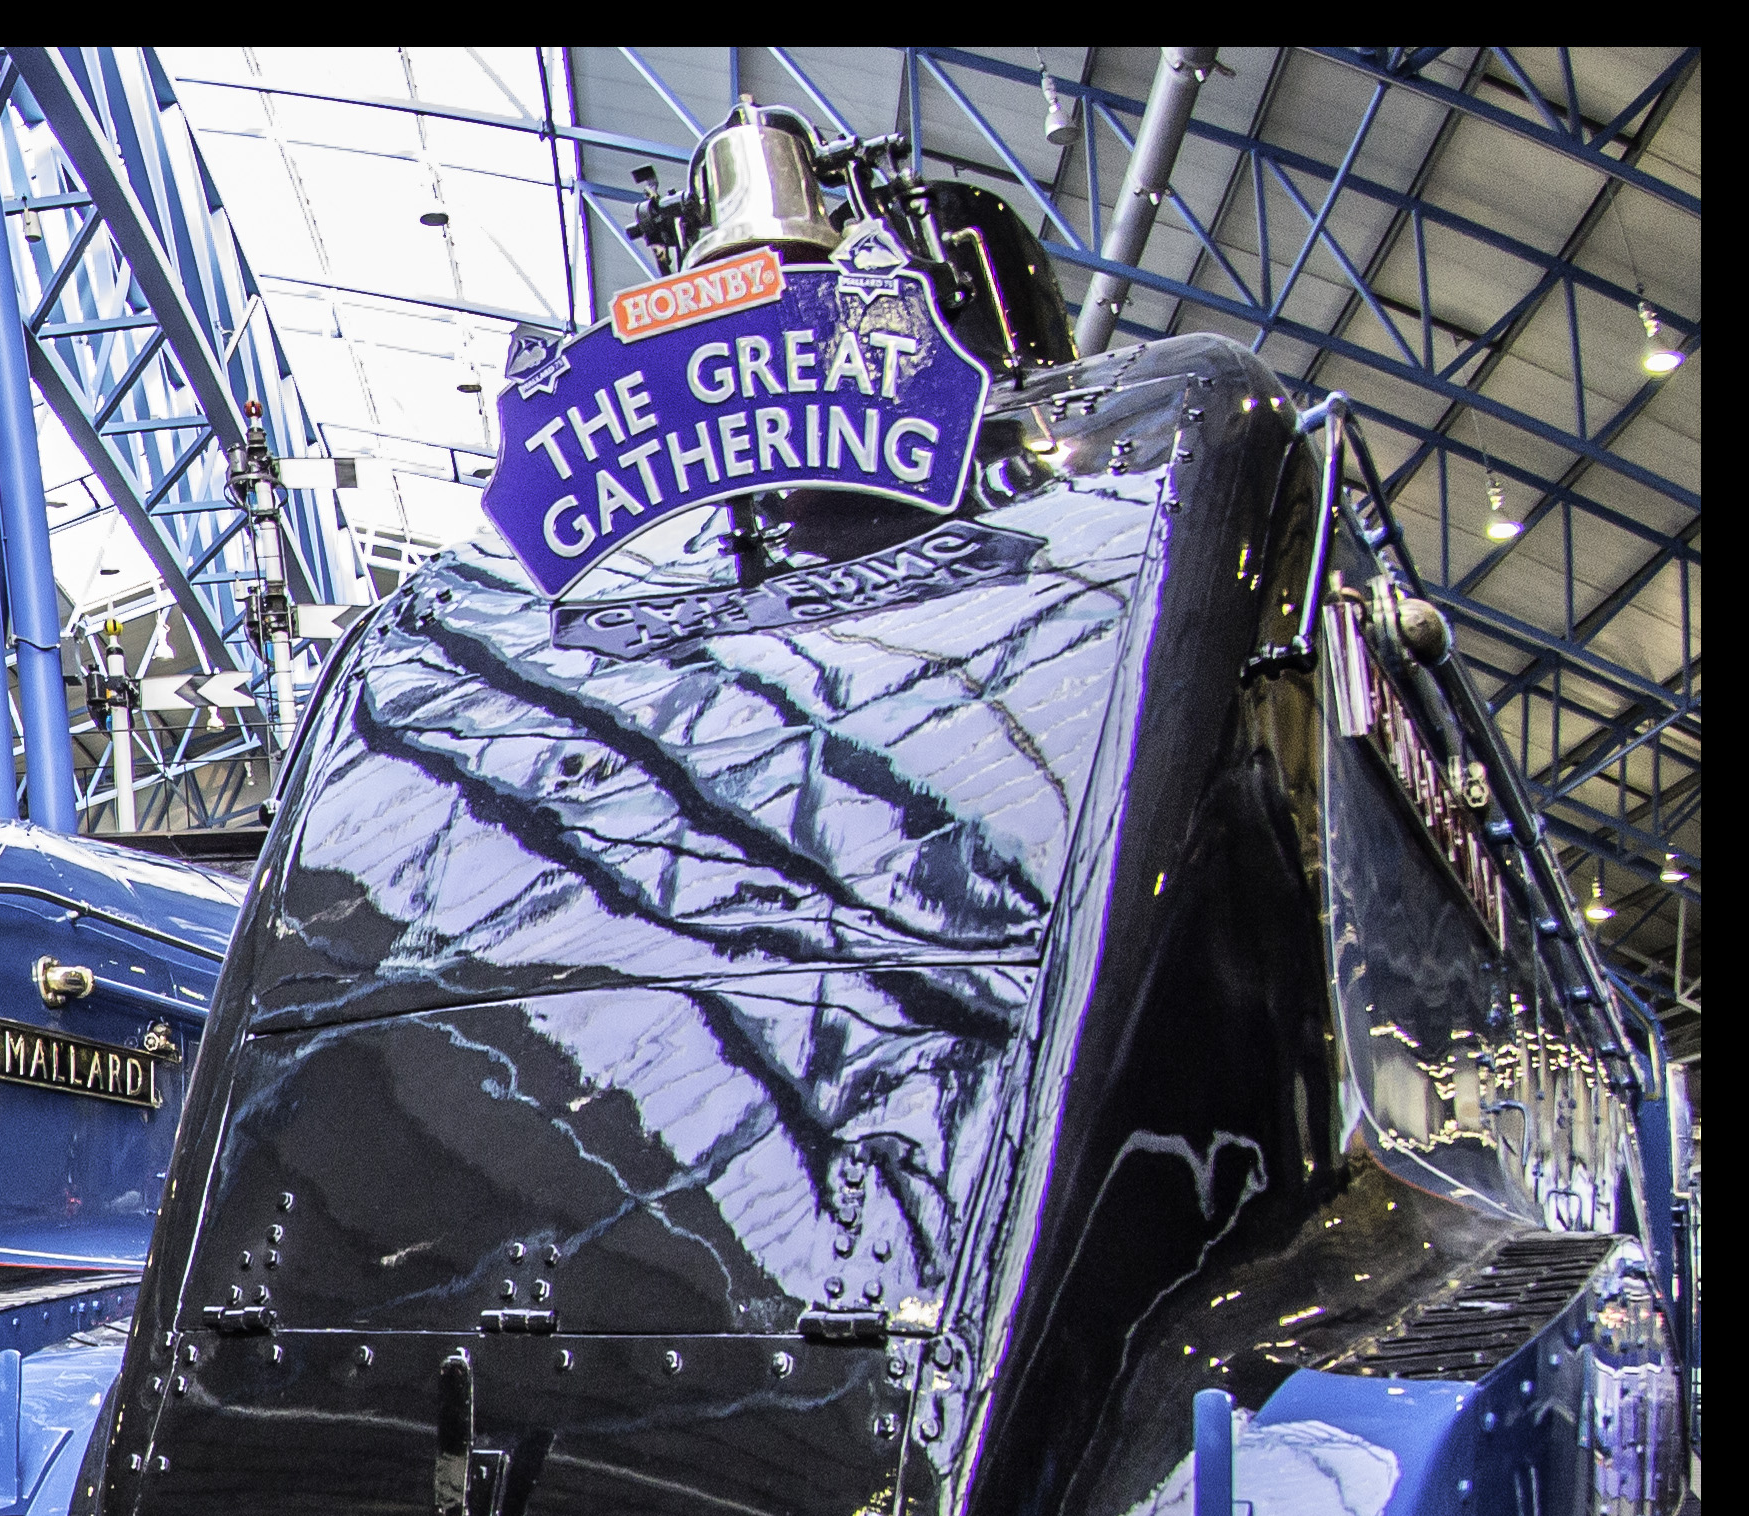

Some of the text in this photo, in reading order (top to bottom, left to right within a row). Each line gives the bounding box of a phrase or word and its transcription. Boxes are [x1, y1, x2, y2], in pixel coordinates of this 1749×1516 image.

[622, 258, 766, 330] HORNBY
[524, 329, 919, 480] THE GREAT
[542, 404, 941, 559] GATHERING
[5, 1030, 143, 1096] MALLARD
